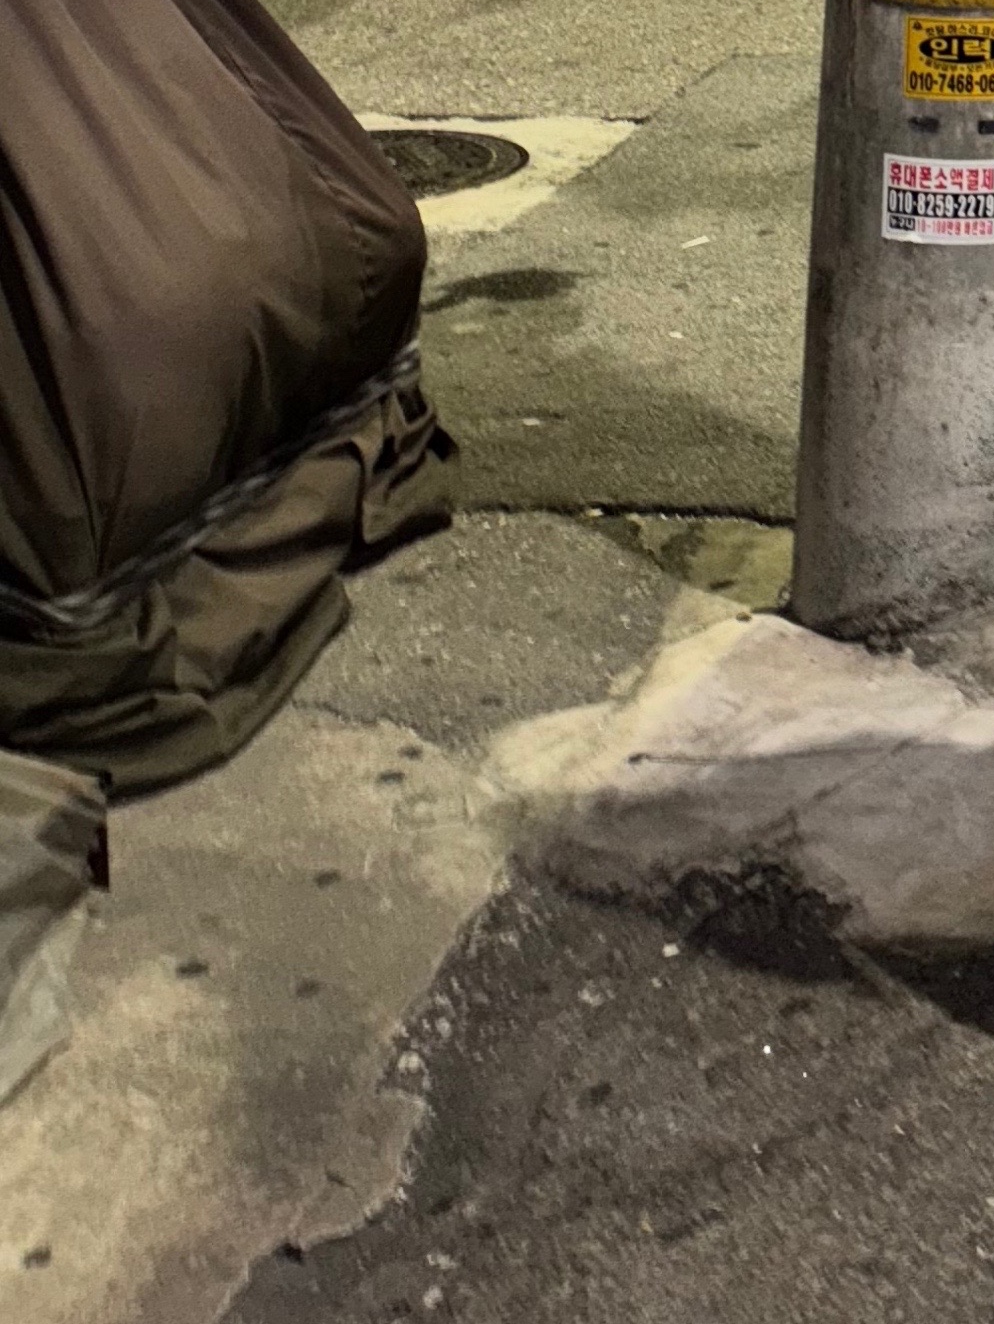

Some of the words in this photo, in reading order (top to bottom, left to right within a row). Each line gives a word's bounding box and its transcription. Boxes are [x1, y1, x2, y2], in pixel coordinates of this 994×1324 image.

[929, 38, 991, 61] 인력
[889, 161, 994, 192] 휴대폰소액결제
[888, 189, 994, 218] 010-8259-2279
